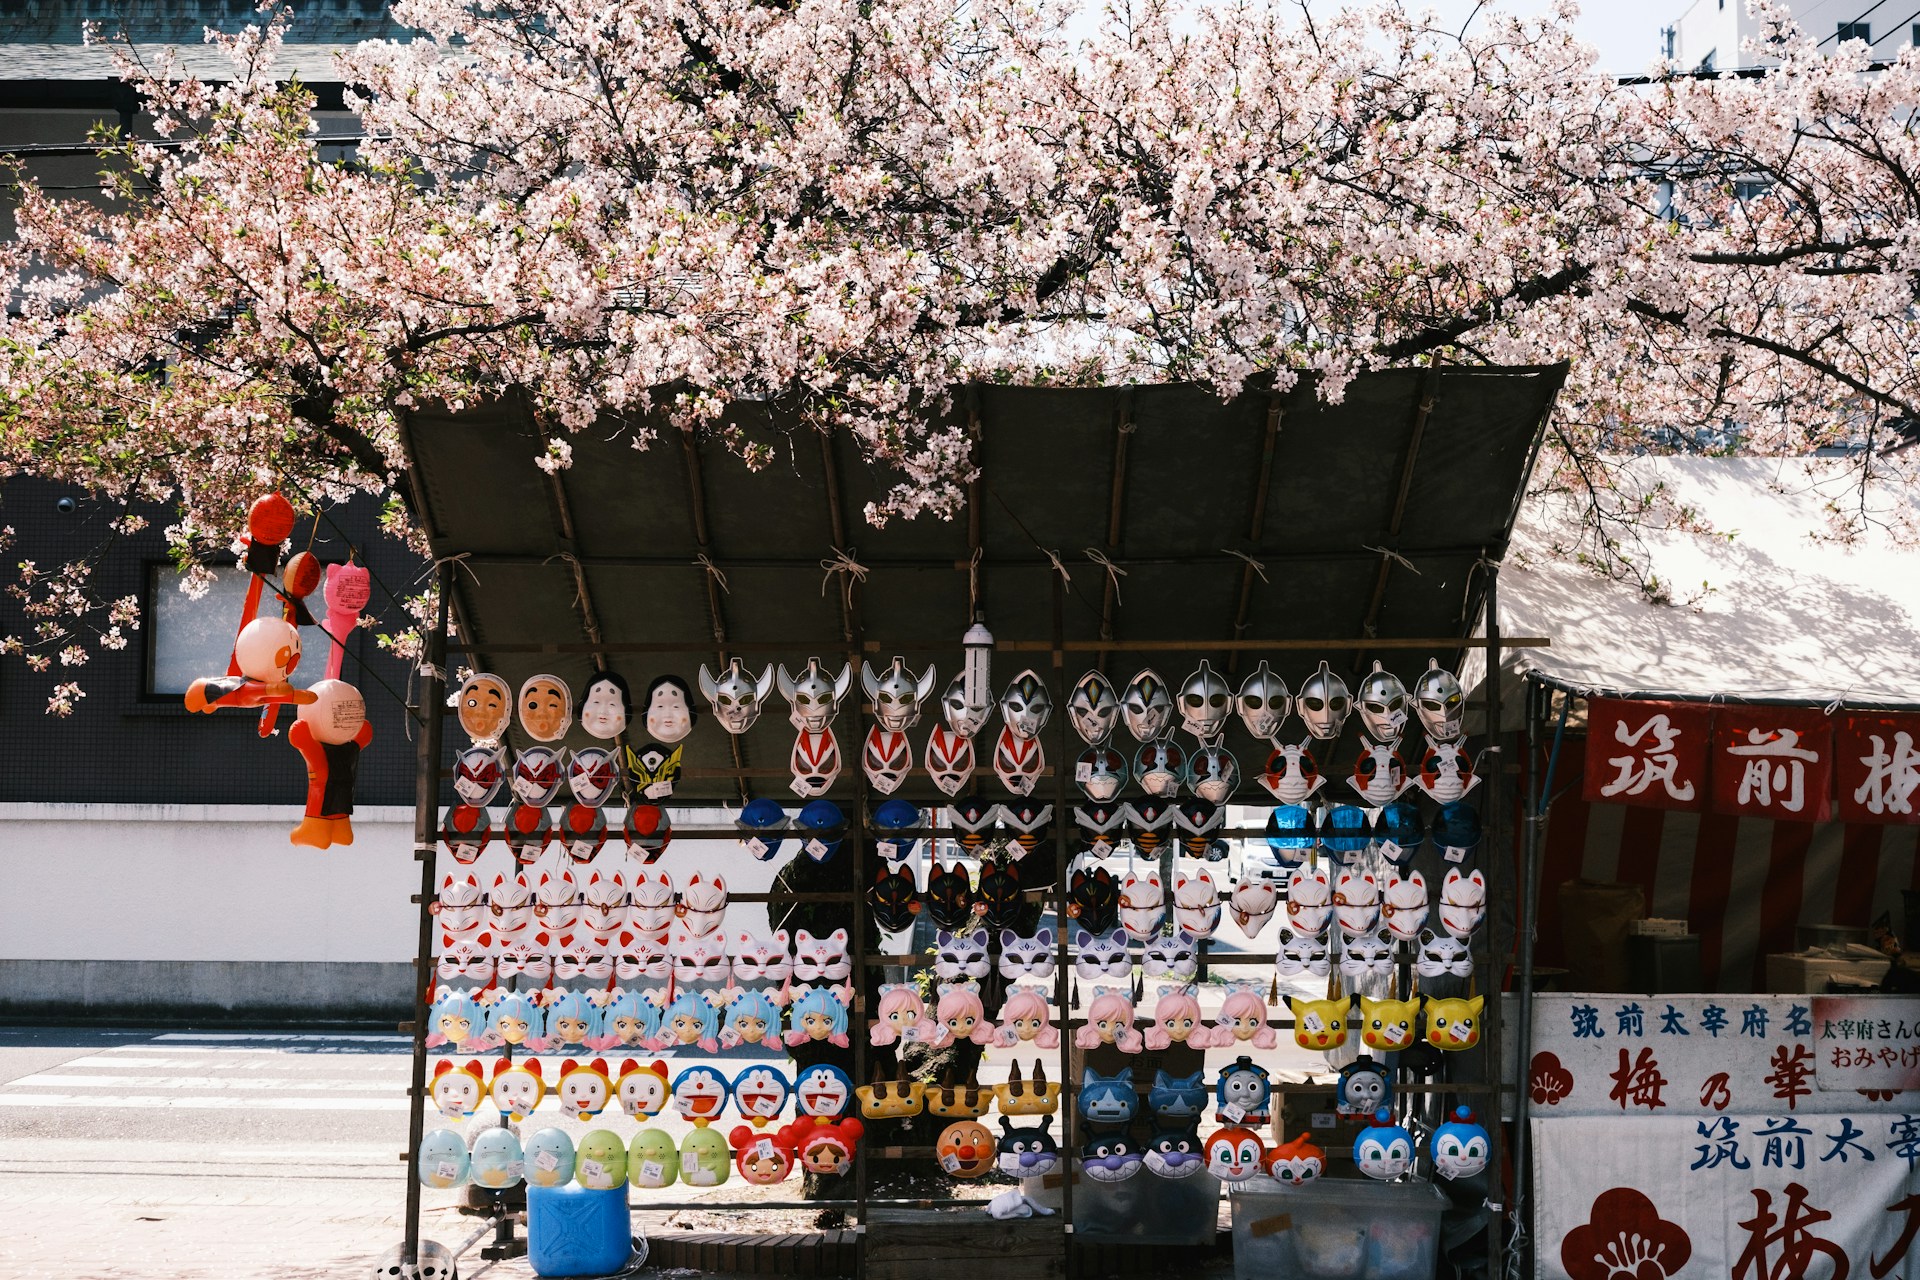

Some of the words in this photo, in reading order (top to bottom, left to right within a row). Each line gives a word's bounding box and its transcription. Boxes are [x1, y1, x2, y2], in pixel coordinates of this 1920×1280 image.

[1570, 1003, 1812, 1039] 筑前太宰府名
[1820, 1019, 1920, 1040] 太宰府さん
[1831, 1045, 1920, 1069] おみやげ
[1609, 1044, 1816, 1111] 梅乃華
